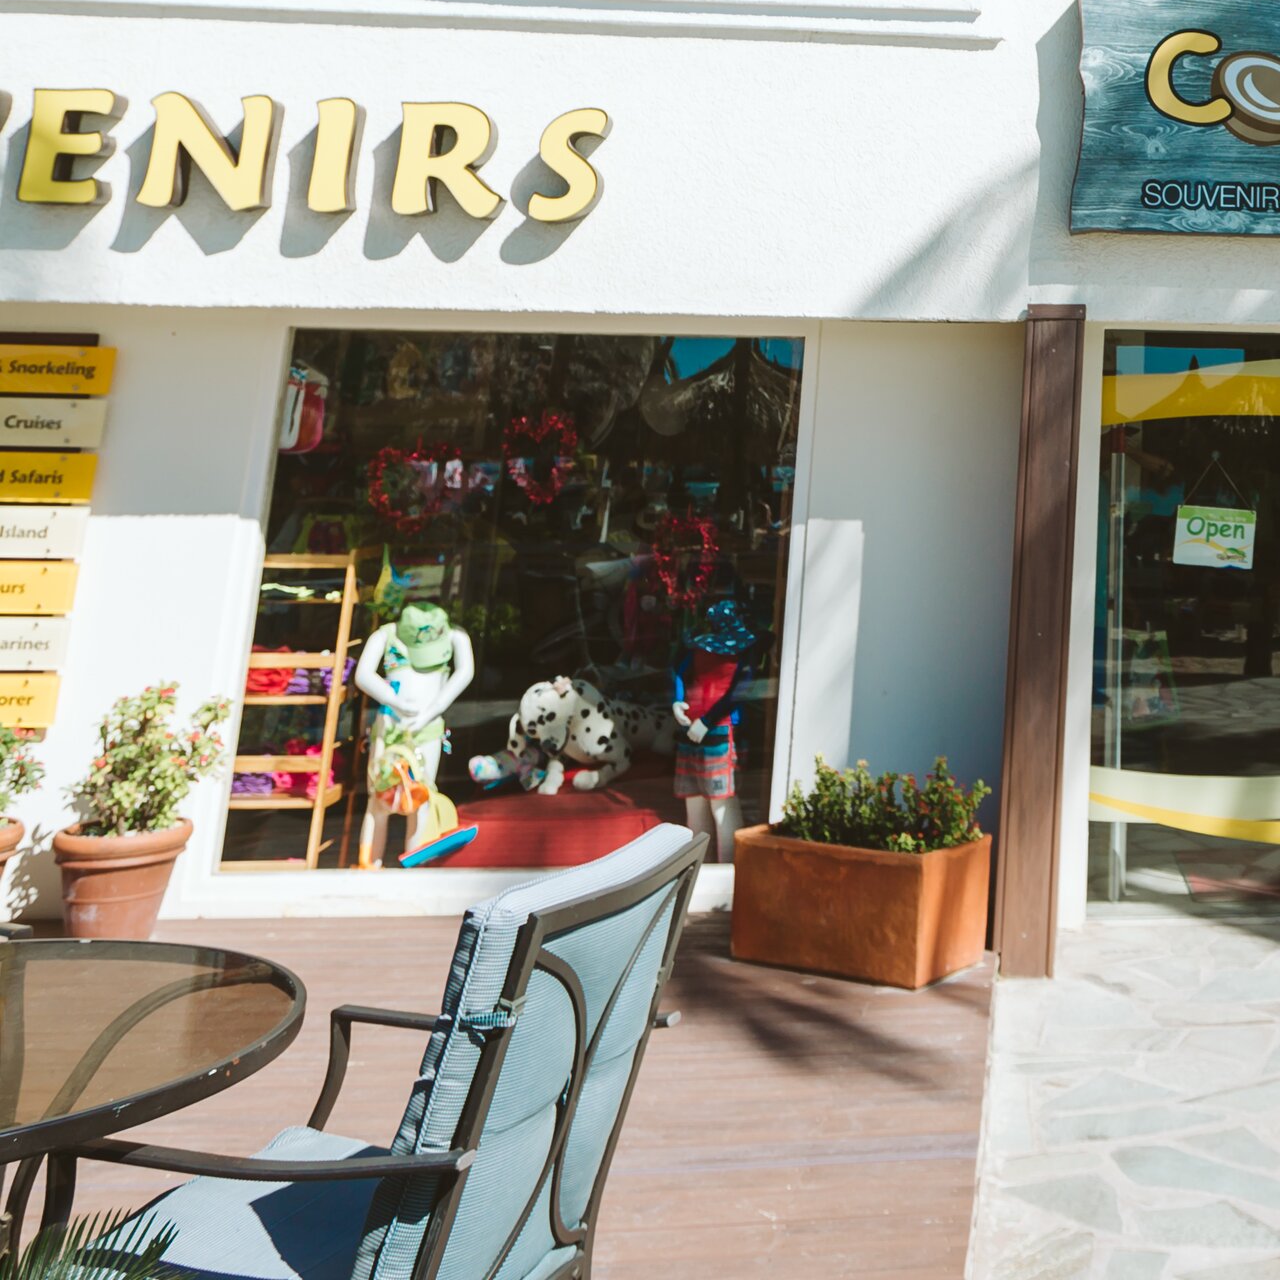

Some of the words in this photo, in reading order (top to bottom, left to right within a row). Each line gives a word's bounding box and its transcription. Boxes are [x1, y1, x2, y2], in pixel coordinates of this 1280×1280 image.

[0, 88, 612, 223] ENIRS
[8, 360, 97, 380] Snorkeling
[4, 414, 63, 430] Cruises
[9, 470, 64, 485] Safaris
[1186, 516, 1246, 543] Open
